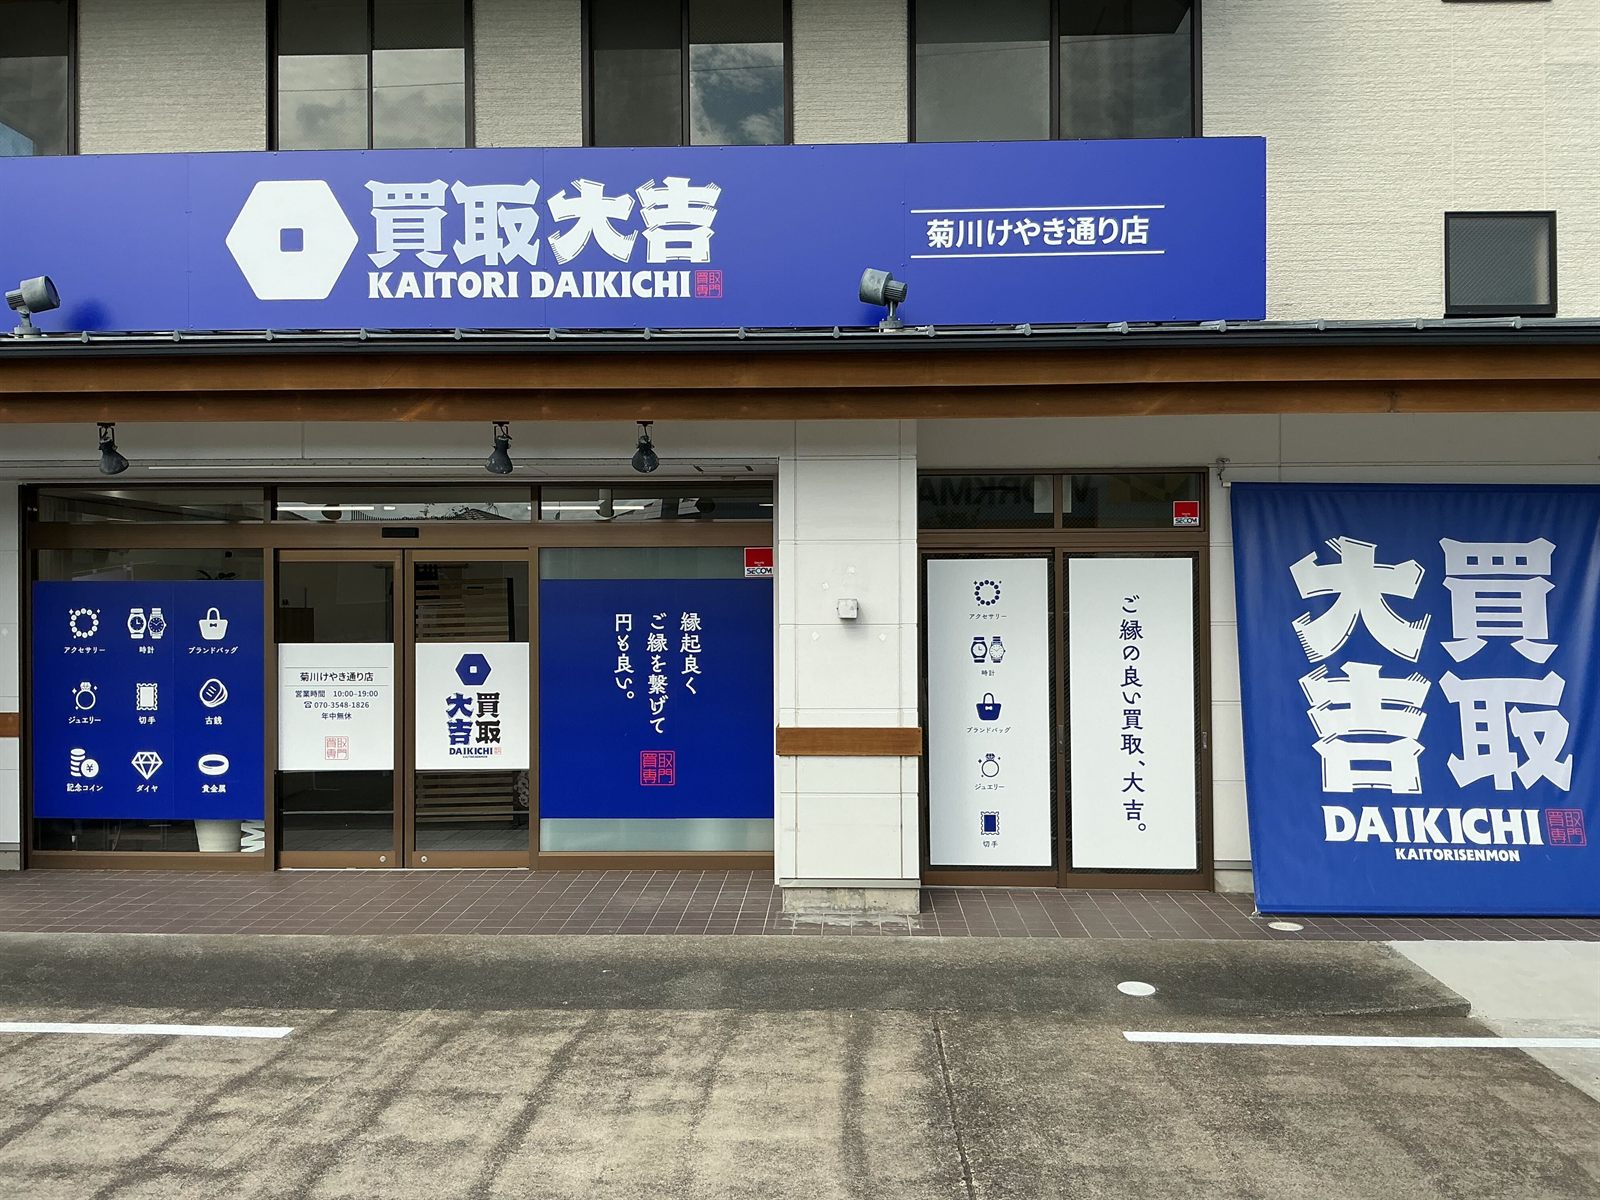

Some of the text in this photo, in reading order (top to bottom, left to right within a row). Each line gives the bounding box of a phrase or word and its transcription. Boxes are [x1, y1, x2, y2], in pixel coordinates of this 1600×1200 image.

[364, 176, 722, 269] 買取大吉
[927, 215, 1149, 248] 菊川けやき通り店
[368, 271, 691, 298] KAITORI DAIKICHI
[747, 567, 772, 575] SECOM
[63, 646, 106, 654] アクセサリー
[138, 645, 155, 654] 時計
[188, 646, 239, 655] ブランドバッグ
[679, 611, 703, 695] 縁起良く
[613, 613, 635, 699] 円も良い。
[1290, 536, 1431, 794] 大吉
[1439, 538, 1572, 791] 買取
[299, 671, 374, 682] 菊川けやき通り店
[646, 612, 669, 734] ご縁を繋げて
[981, 669, 995, 677] 時計
[295, 689, 326, 698] 営業時間
[313, 701, 370, 709] 070-3548-1826
[321, 711, 352, 721] 年中無休
[474, 691, 501, 745] 買取
[1118, 594, 1147, 832] ご縁の良い買取、大吉。
[68, 715, 102, 725] ジュエリー
[138, 715, 156, 725] 切手
[204, 715, 223, 725] 古銭
[445, 692, 474, 746] 大吉
[966, 726, 1012, 734] ブランドバッグ
[449, 747, 493, 756] DAIKICHI
[66, 782, 104, 793] 記念コイン
[136, 784, 159, 793] ダイヤ
[201, 784, 227, 794] 貴金属
[974, 783, 1005, 791] ジュエリー
[1322, 806, 1544, 845] DAIKICHI
[982, 840, 999, 848] 切手
[1395, 848, 1520, 861] KAITORISENMON
